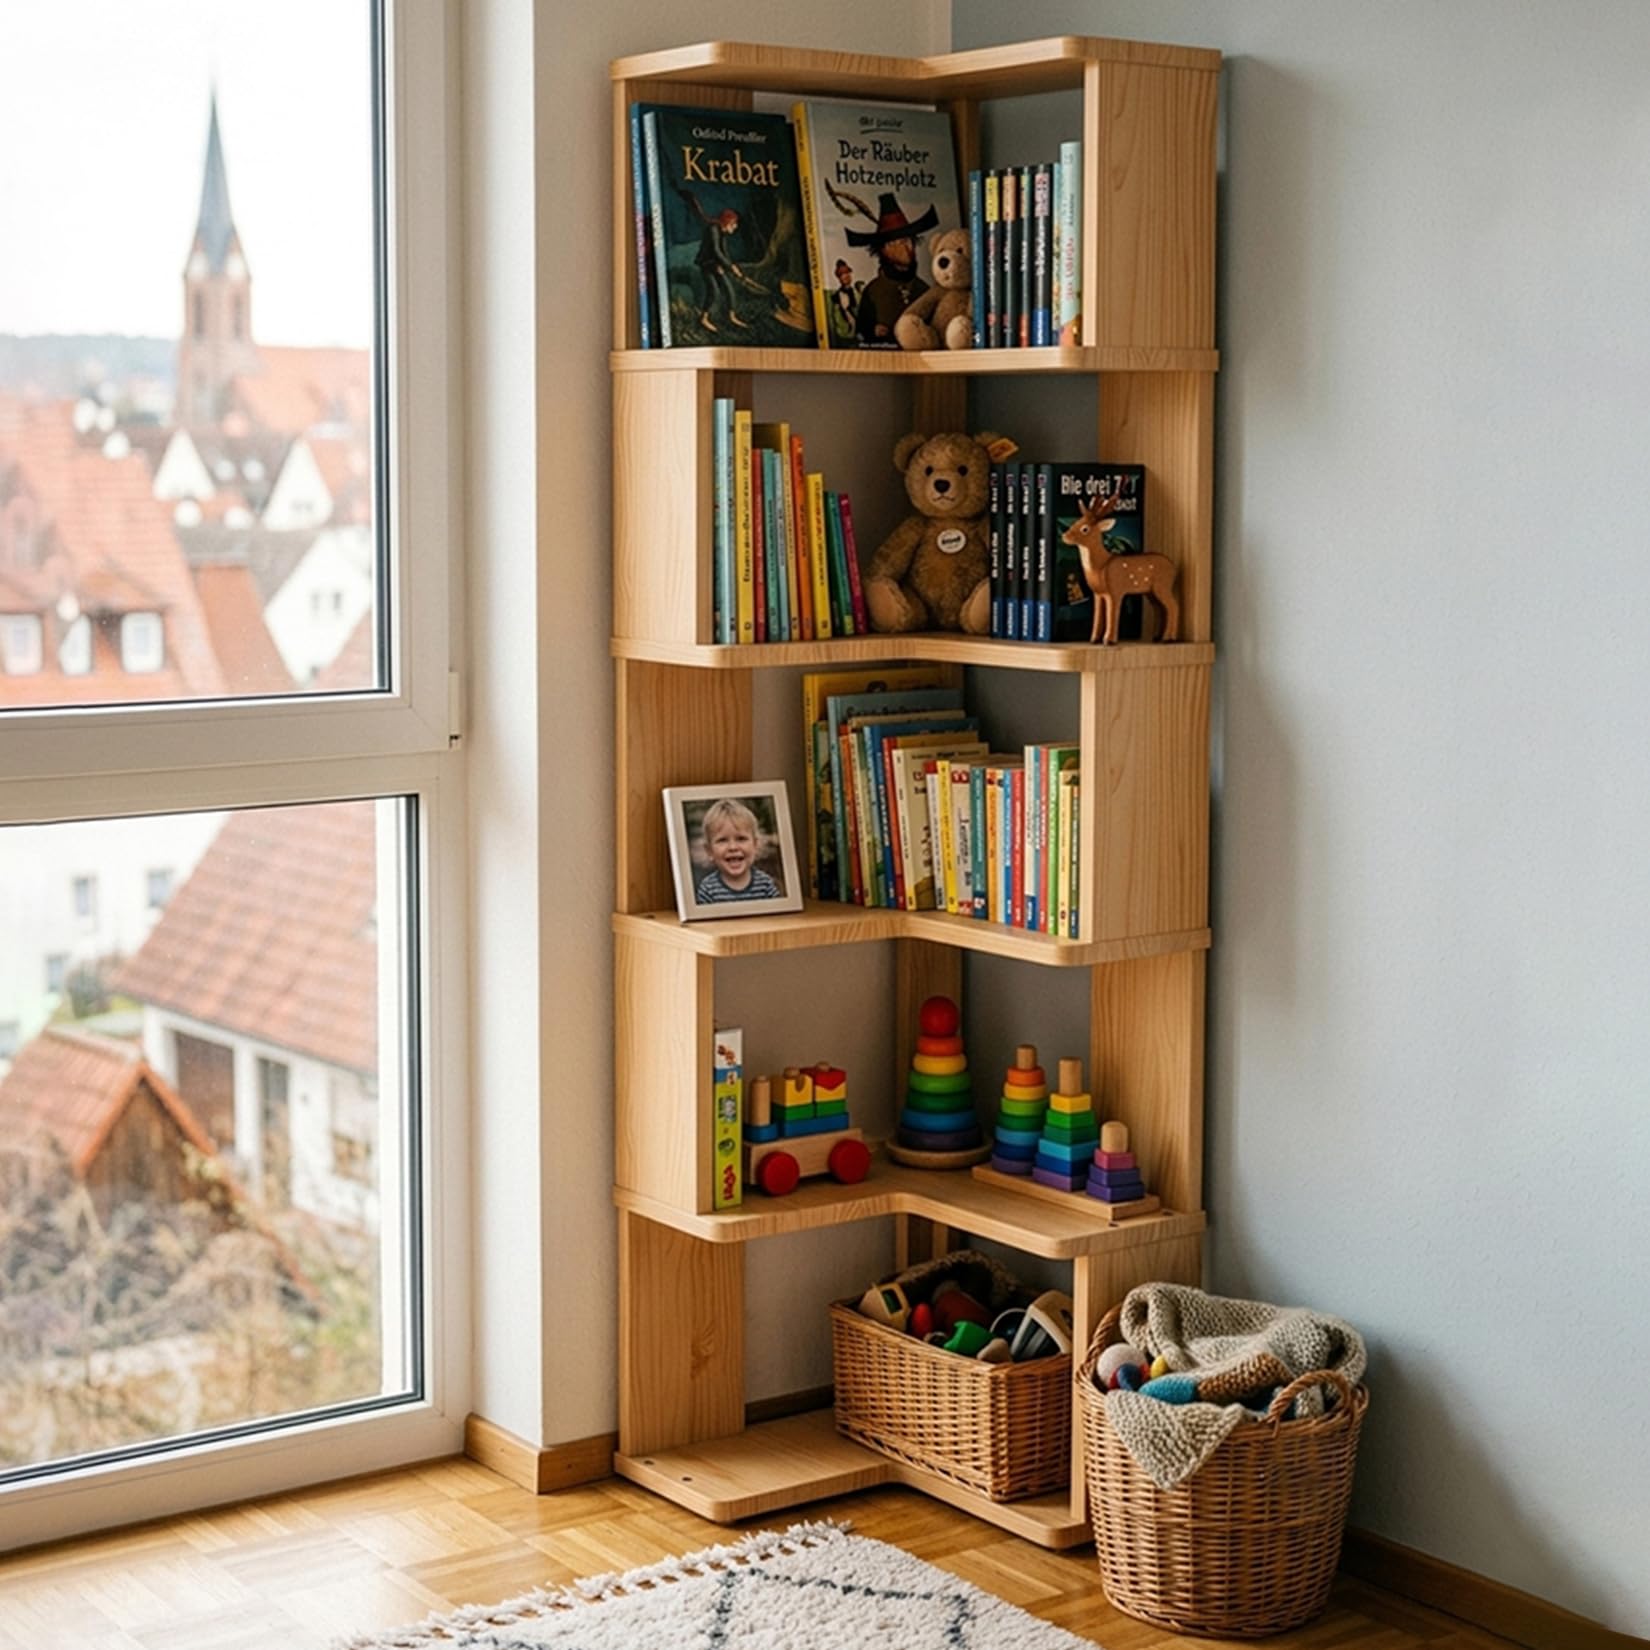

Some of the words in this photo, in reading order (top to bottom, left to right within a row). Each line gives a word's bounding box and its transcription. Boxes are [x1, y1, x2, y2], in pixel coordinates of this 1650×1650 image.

[838, 139, 867, 160] Der
[870, 139, 929, 164] Räuber
[681, 145, 779, 187] Krabat
[836, 160, 937, 192] Hotzenplotz
[1085, 474, 1111, 495] drei
